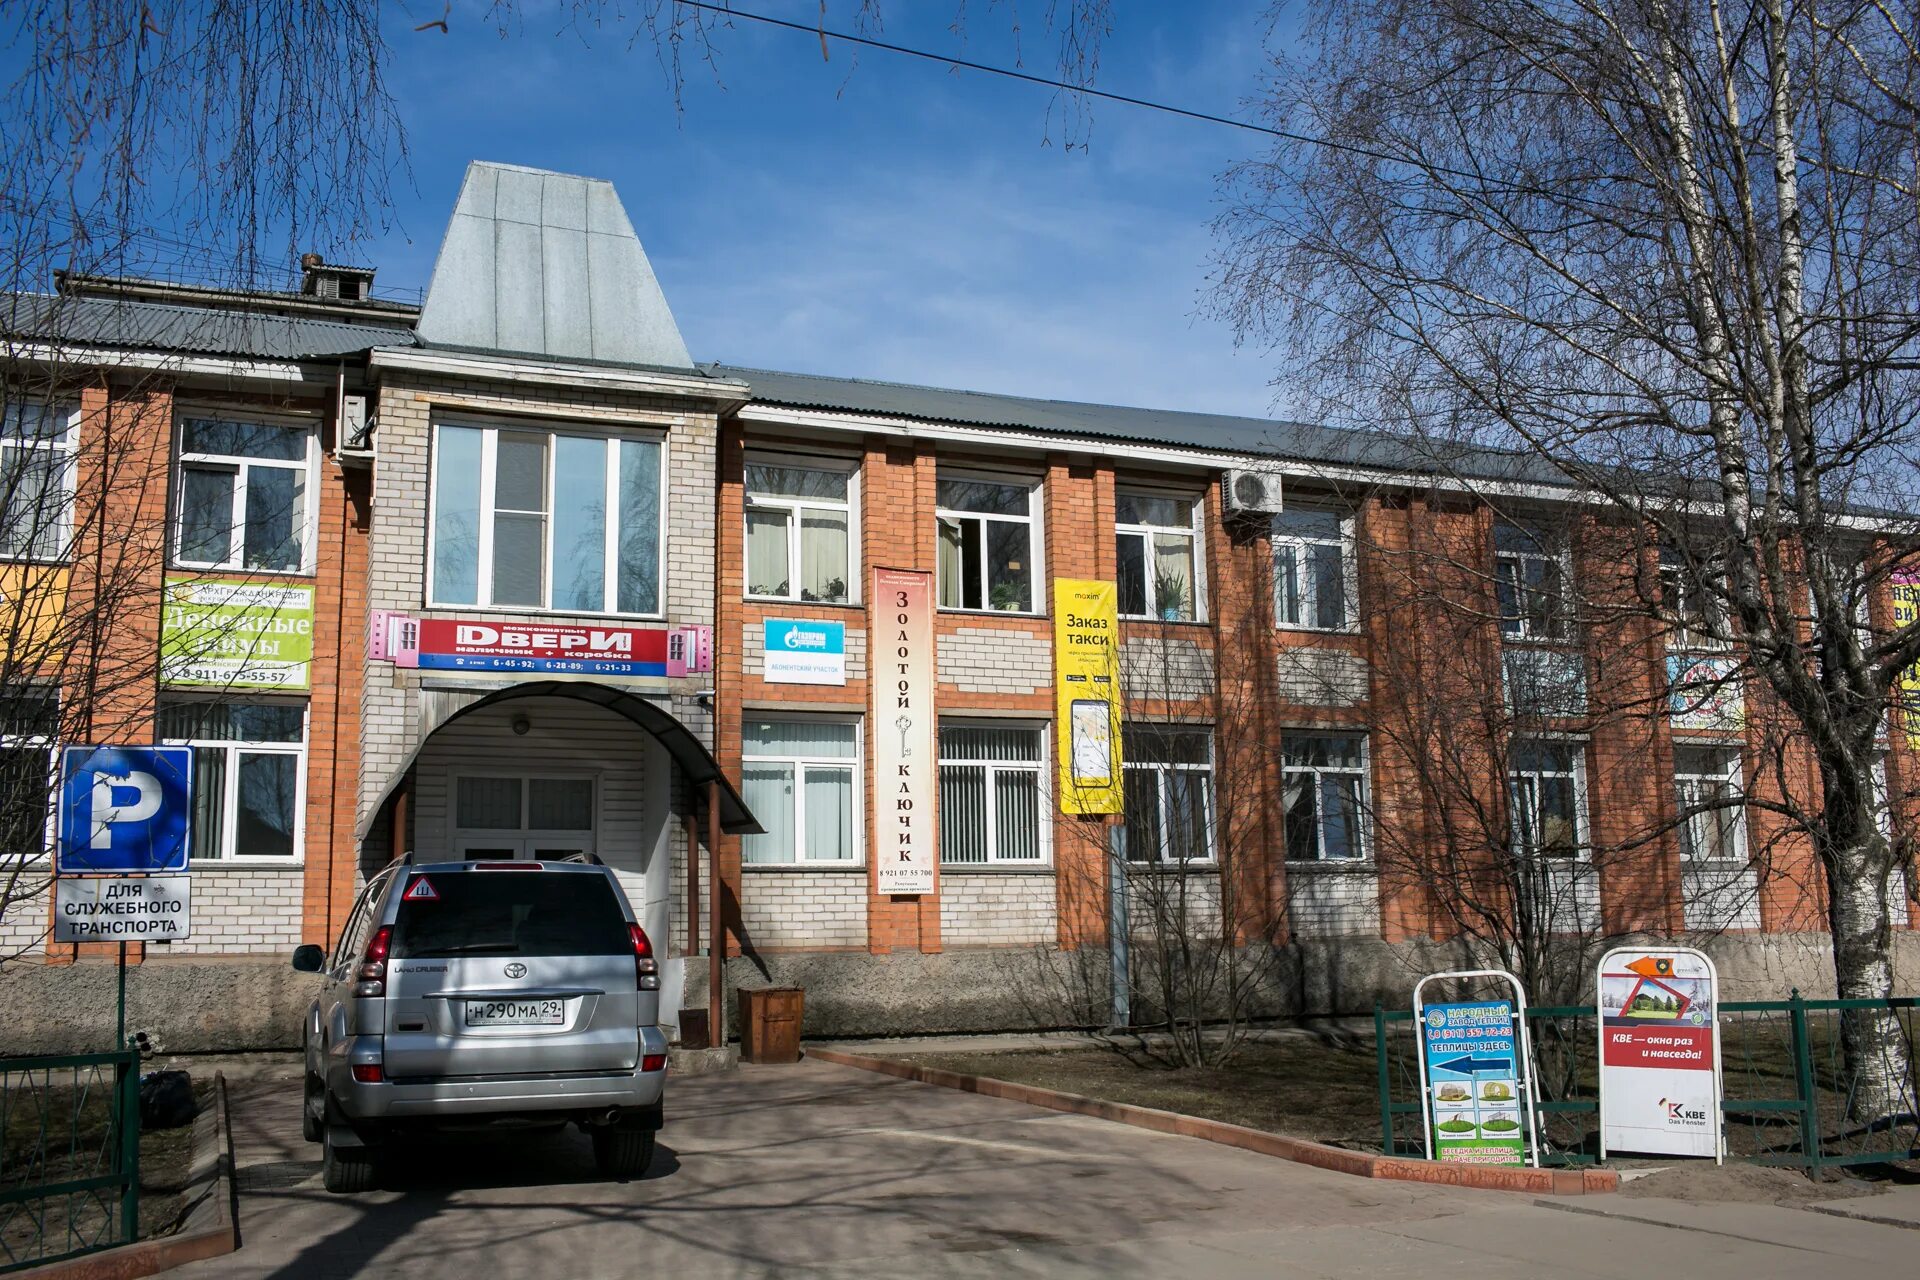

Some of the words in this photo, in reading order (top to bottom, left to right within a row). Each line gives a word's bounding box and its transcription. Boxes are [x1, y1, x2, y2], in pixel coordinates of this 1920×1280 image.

[163, 606, 310, 634] Денежные
[1067, 613, 1107, 628] Заказ
[1067, 634, 1109, 645] такси
[456, 646, 534, 655] наличник
[564, 651, 632, 659] коробка
[771, 664, 812, 672] АБОНЕНТСКИЙ
[813, 665, 839, 673] УЧАСТОК
[897, 764, 913, 862] КЛЮЧИК
[106, 884, 142, 899] ДЛЯ
[416, 886, 429, 896] Ш
[64, 900, 182, 916] СЛУЖЕБНОГО
[69, 919, 177, 935] ТРАНСПОРТА
[1447, 1005, 1508, 1018] НАРОДНЫЙ
[1447, 1018, 1476, 1026] ЗАВОД
[1432, 1042, 1477, 1052] ТЕПЛИЦЫ
[1480, 1041, 1511, 1052] ЗДЕСЬ
[1646, 1036, 1672, 1045] окна
[1673, 1037, 1693, 1047] раз
[1650, 1050, 1702, 1060] навсегда!
[1685, 1110, 1706, 1120] KBE
[1442, 1148, 1473, 1156] БЕСЕДКА
[1482, 1147, 1514, 1156] ТЕПЛИЦА
